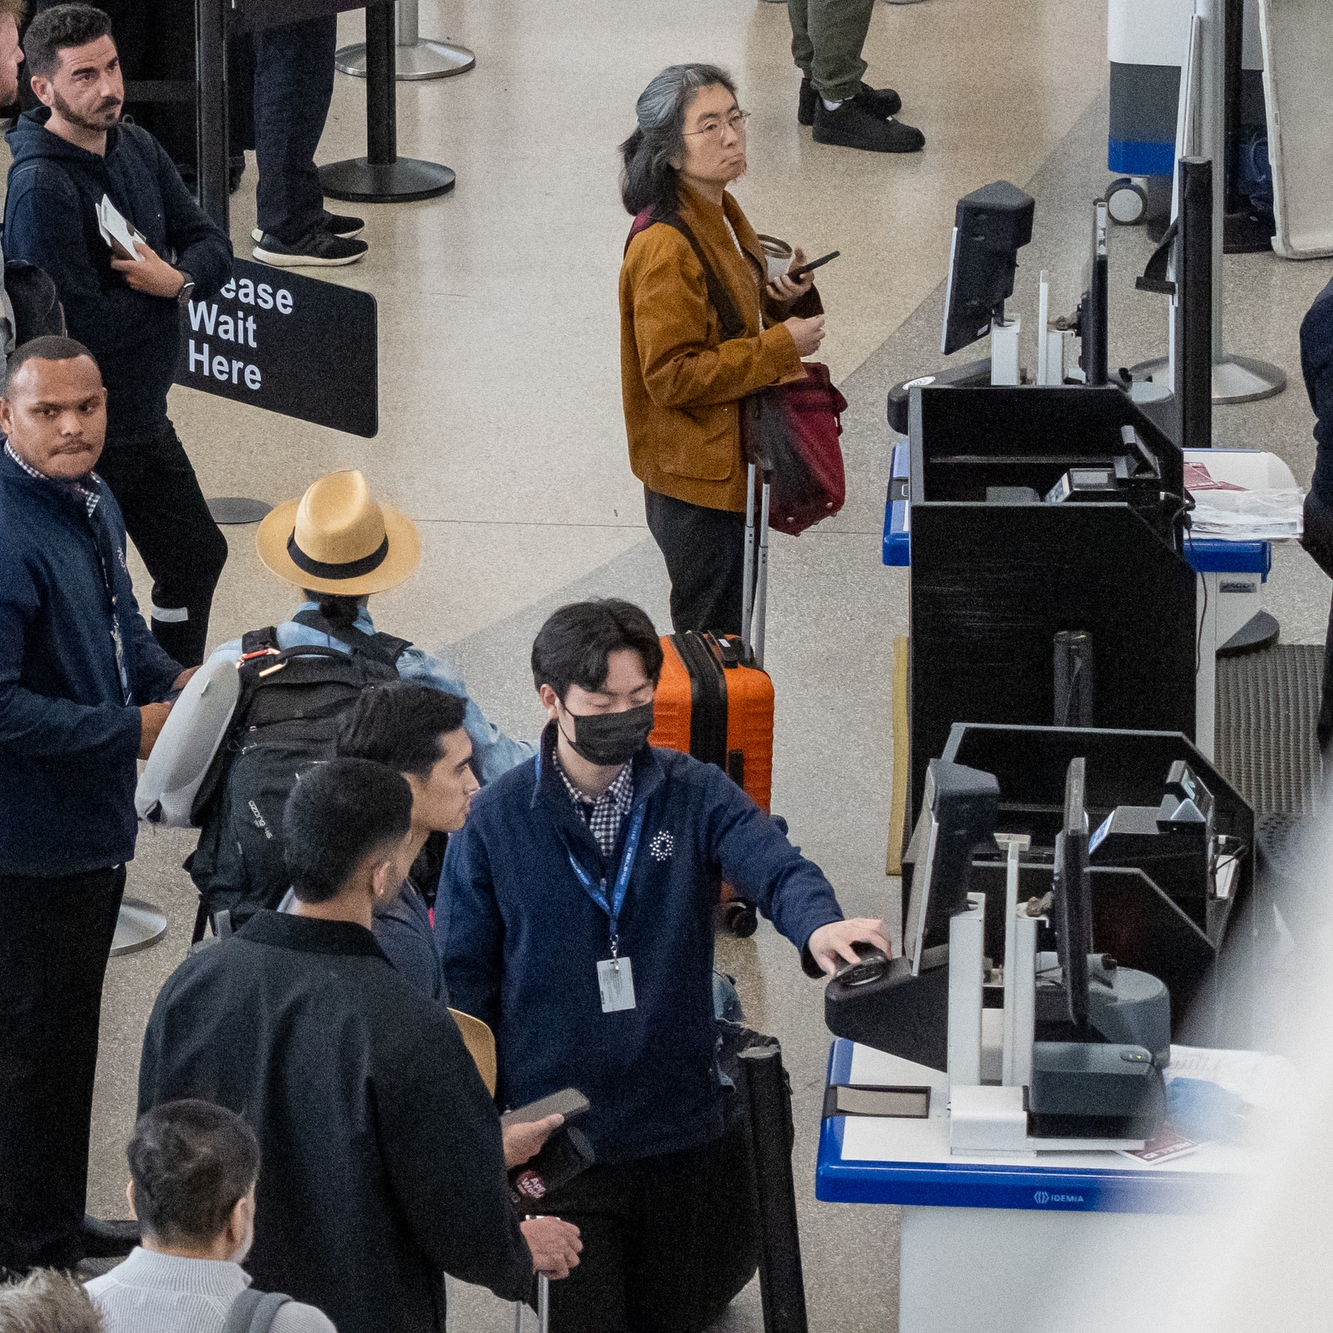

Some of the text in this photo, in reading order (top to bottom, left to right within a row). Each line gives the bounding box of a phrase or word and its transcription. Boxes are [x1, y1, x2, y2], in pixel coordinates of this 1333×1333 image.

[220, 277, 293, 315] ease
[188, 299, 257, 348] Wait
[188, 338, 262, 390] Here
[1050, 1194, 1084, 1202] IDEMIA
